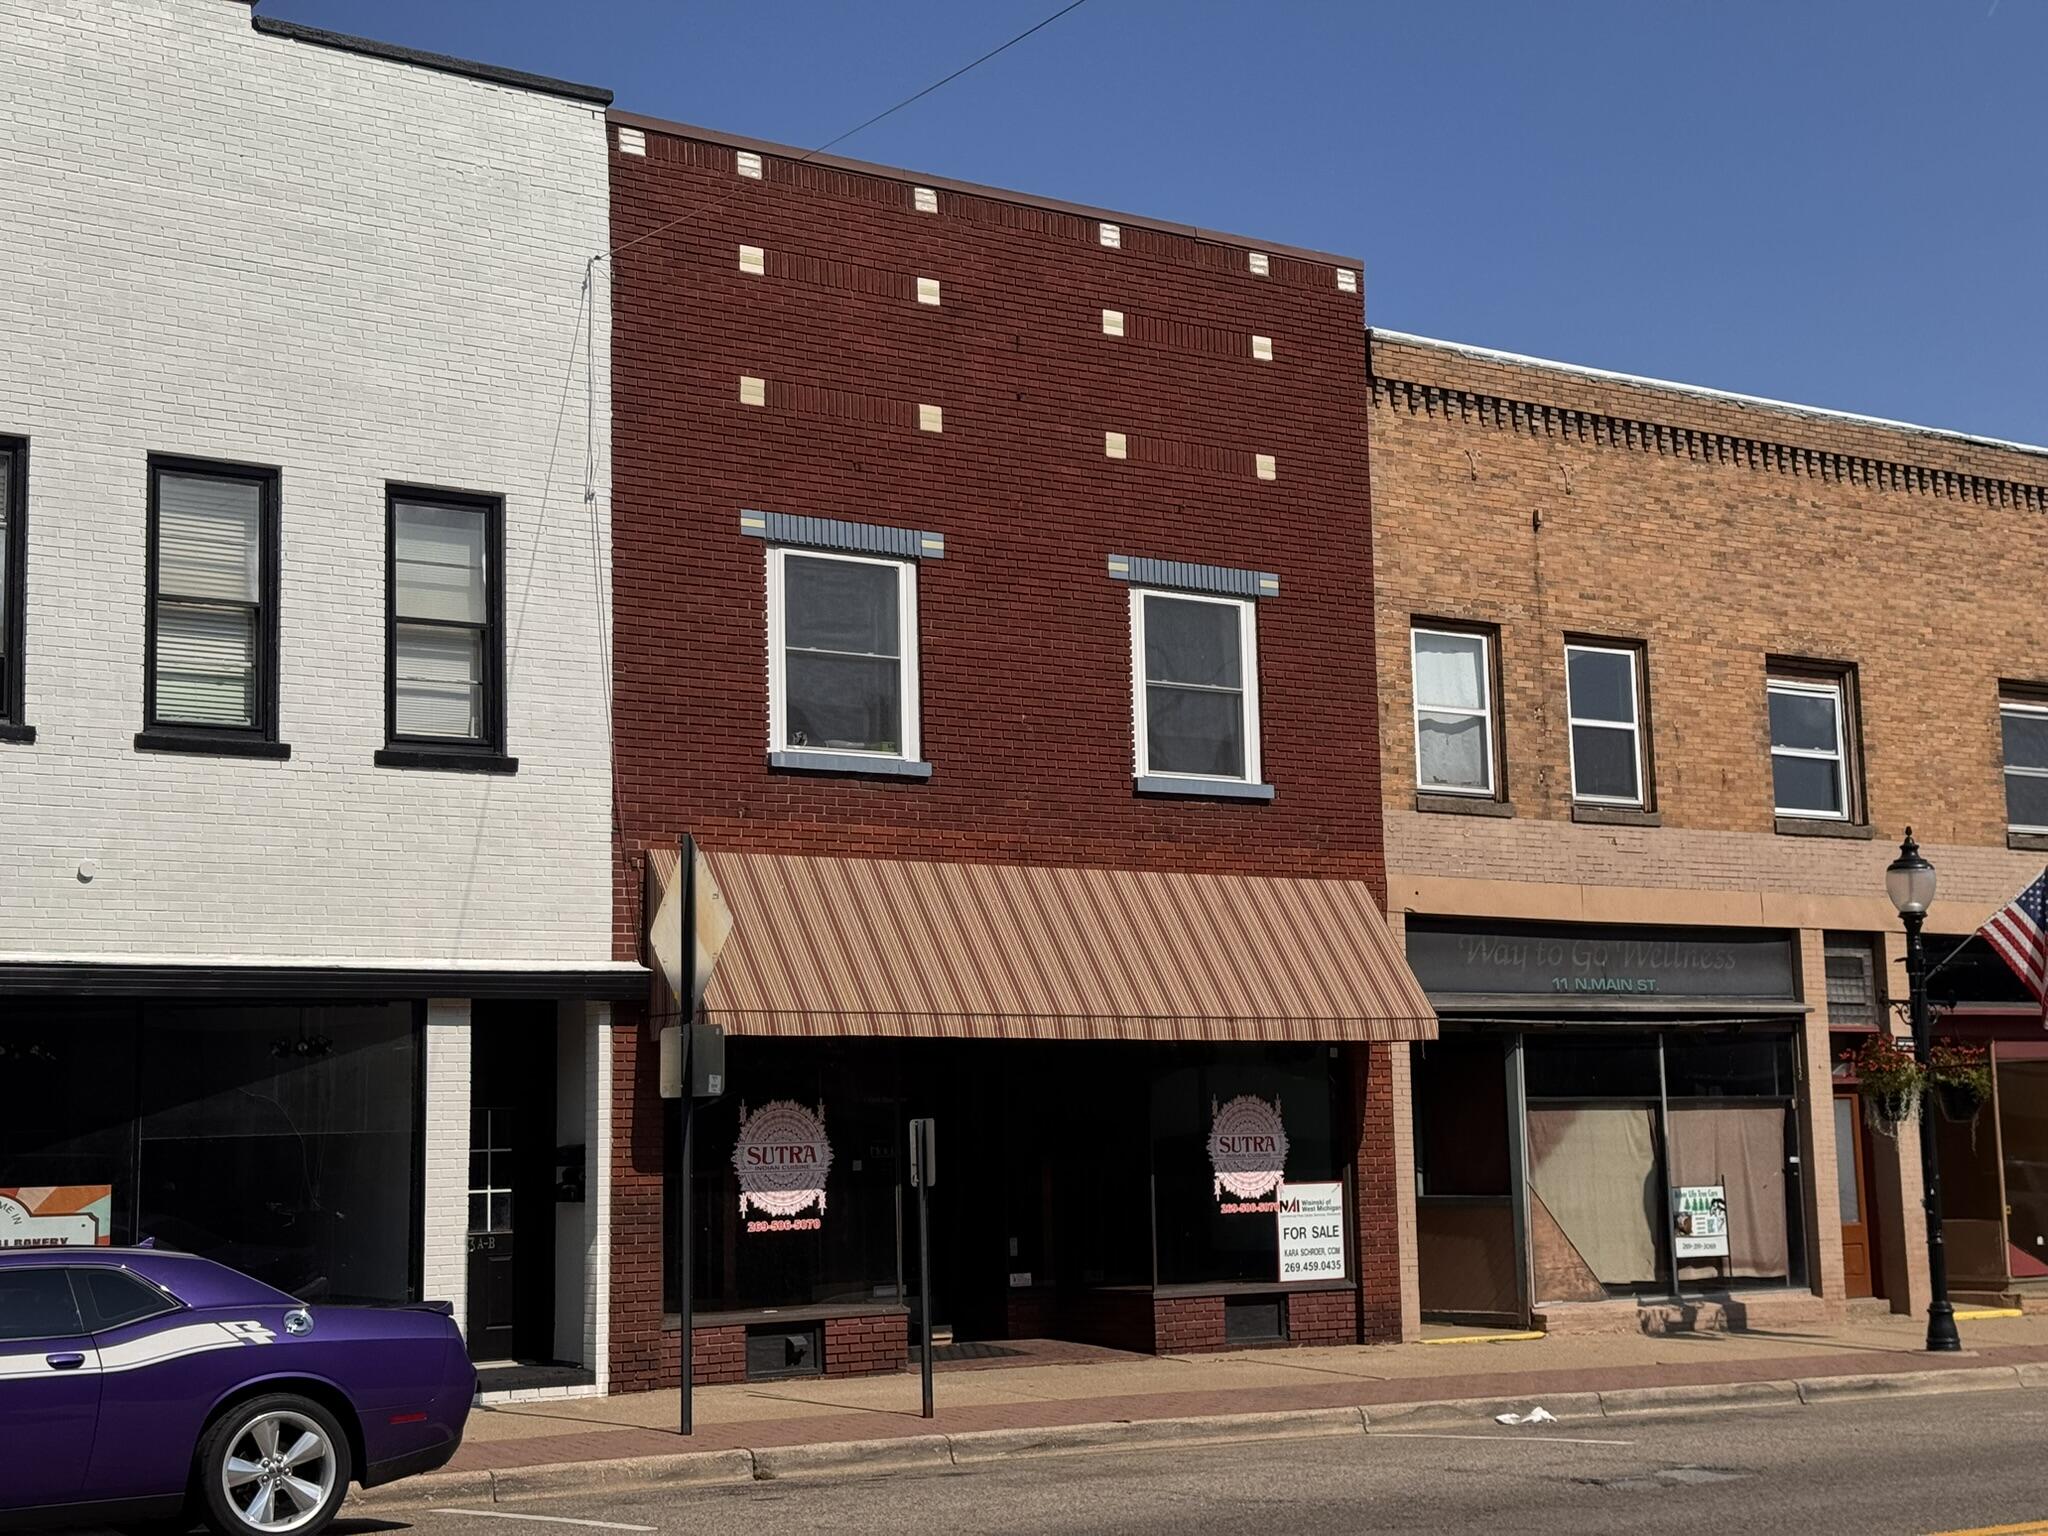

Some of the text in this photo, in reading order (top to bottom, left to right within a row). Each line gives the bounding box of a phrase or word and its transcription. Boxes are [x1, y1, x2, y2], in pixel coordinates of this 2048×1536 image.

[1457, 937, 1737, 973] Way to Go Wellness
[1552, 977, 1569, 990] 11
[1637, 979, 1660, 992] ST.
[1219, 1135, 1276, 1154] SUTRA
[747, 1144, 818, 1166] SUTRA
[1280, 1197, 1300, 1213] NAI
[1317, 1205, 1341, 1213] Michigan
[11, 1213, 23, 1225] IN
[1283, 1225, 1340, 1240] FOR SALE
[1284, 1248, 1299, 1257] KARA
[1284, 1260, 1342, 1273] 269.459.0435
